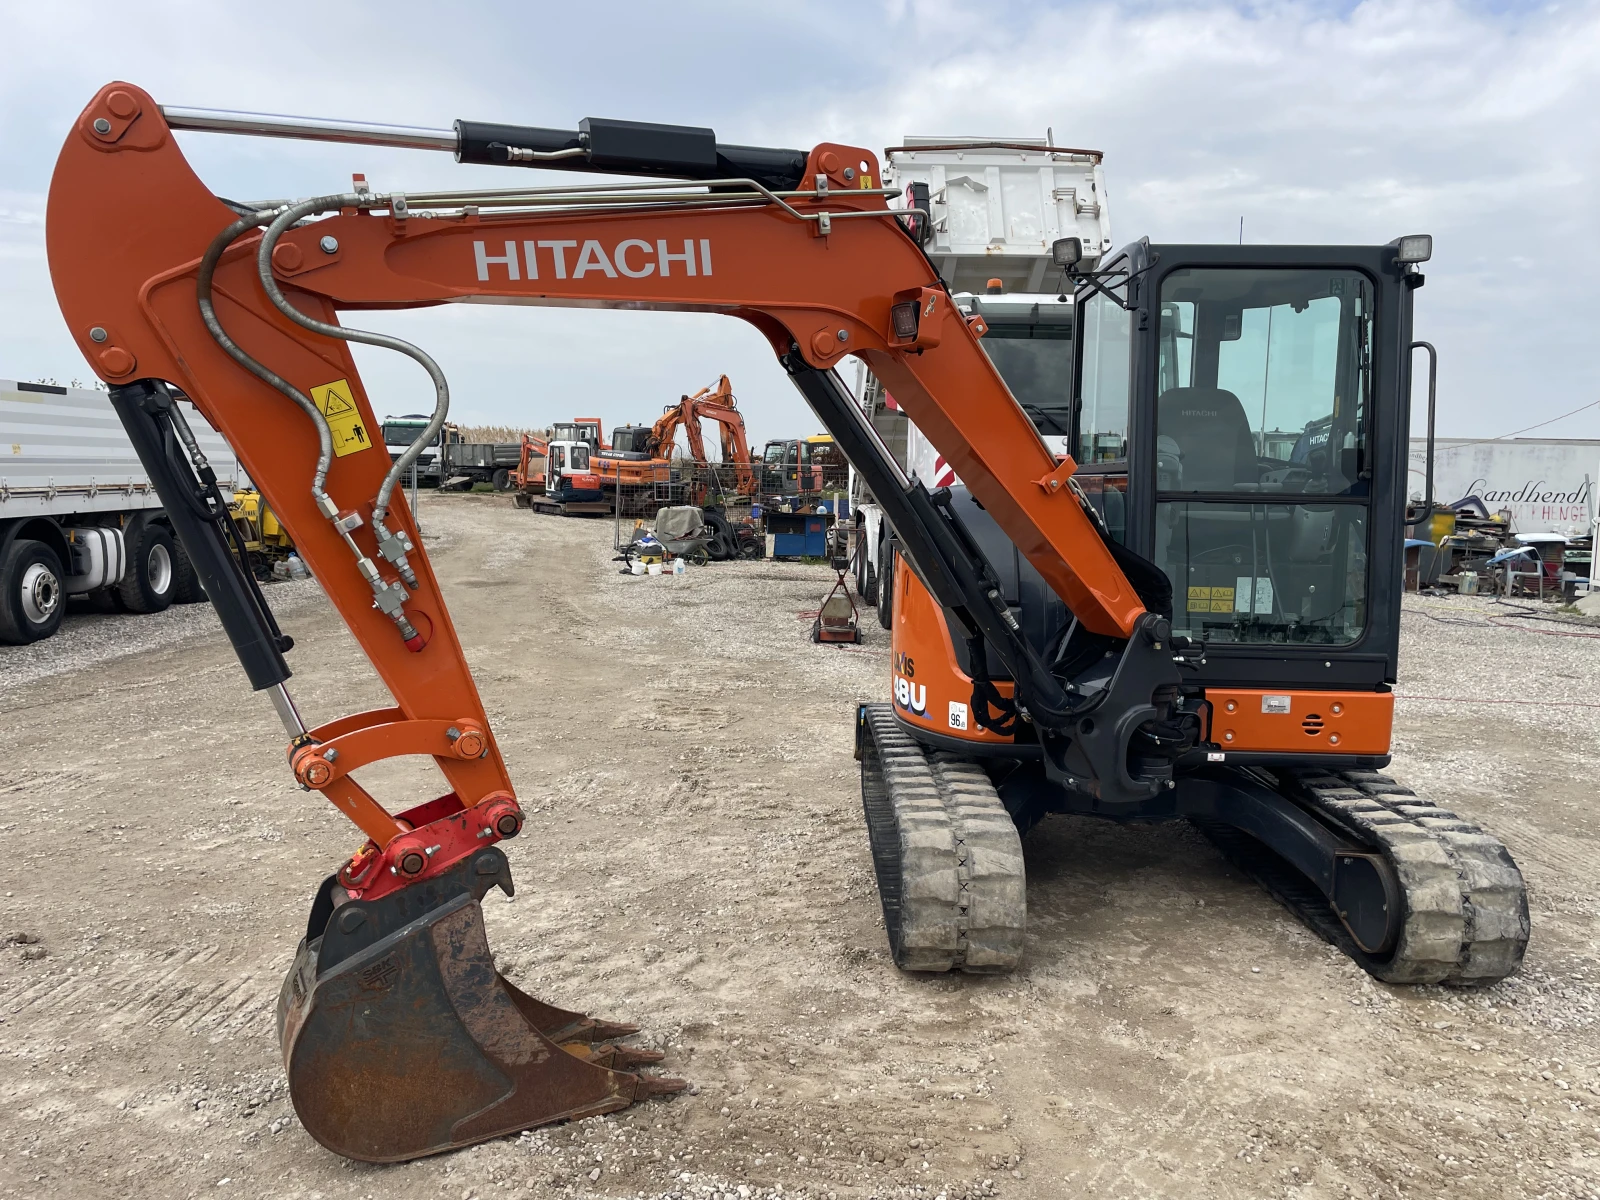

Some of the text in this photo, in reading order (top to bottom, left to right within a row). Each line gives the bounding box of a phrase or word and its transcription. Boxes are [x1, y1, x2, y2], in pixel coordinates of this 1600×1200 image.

[473, 238, 713, 281] HITACHI
[1181, 409, 1217, 417] HITACHI
[893, 675, 927, 713] 48U
[951, 713, 960, 727] 96
[363, 957, 391, 978] SBK
